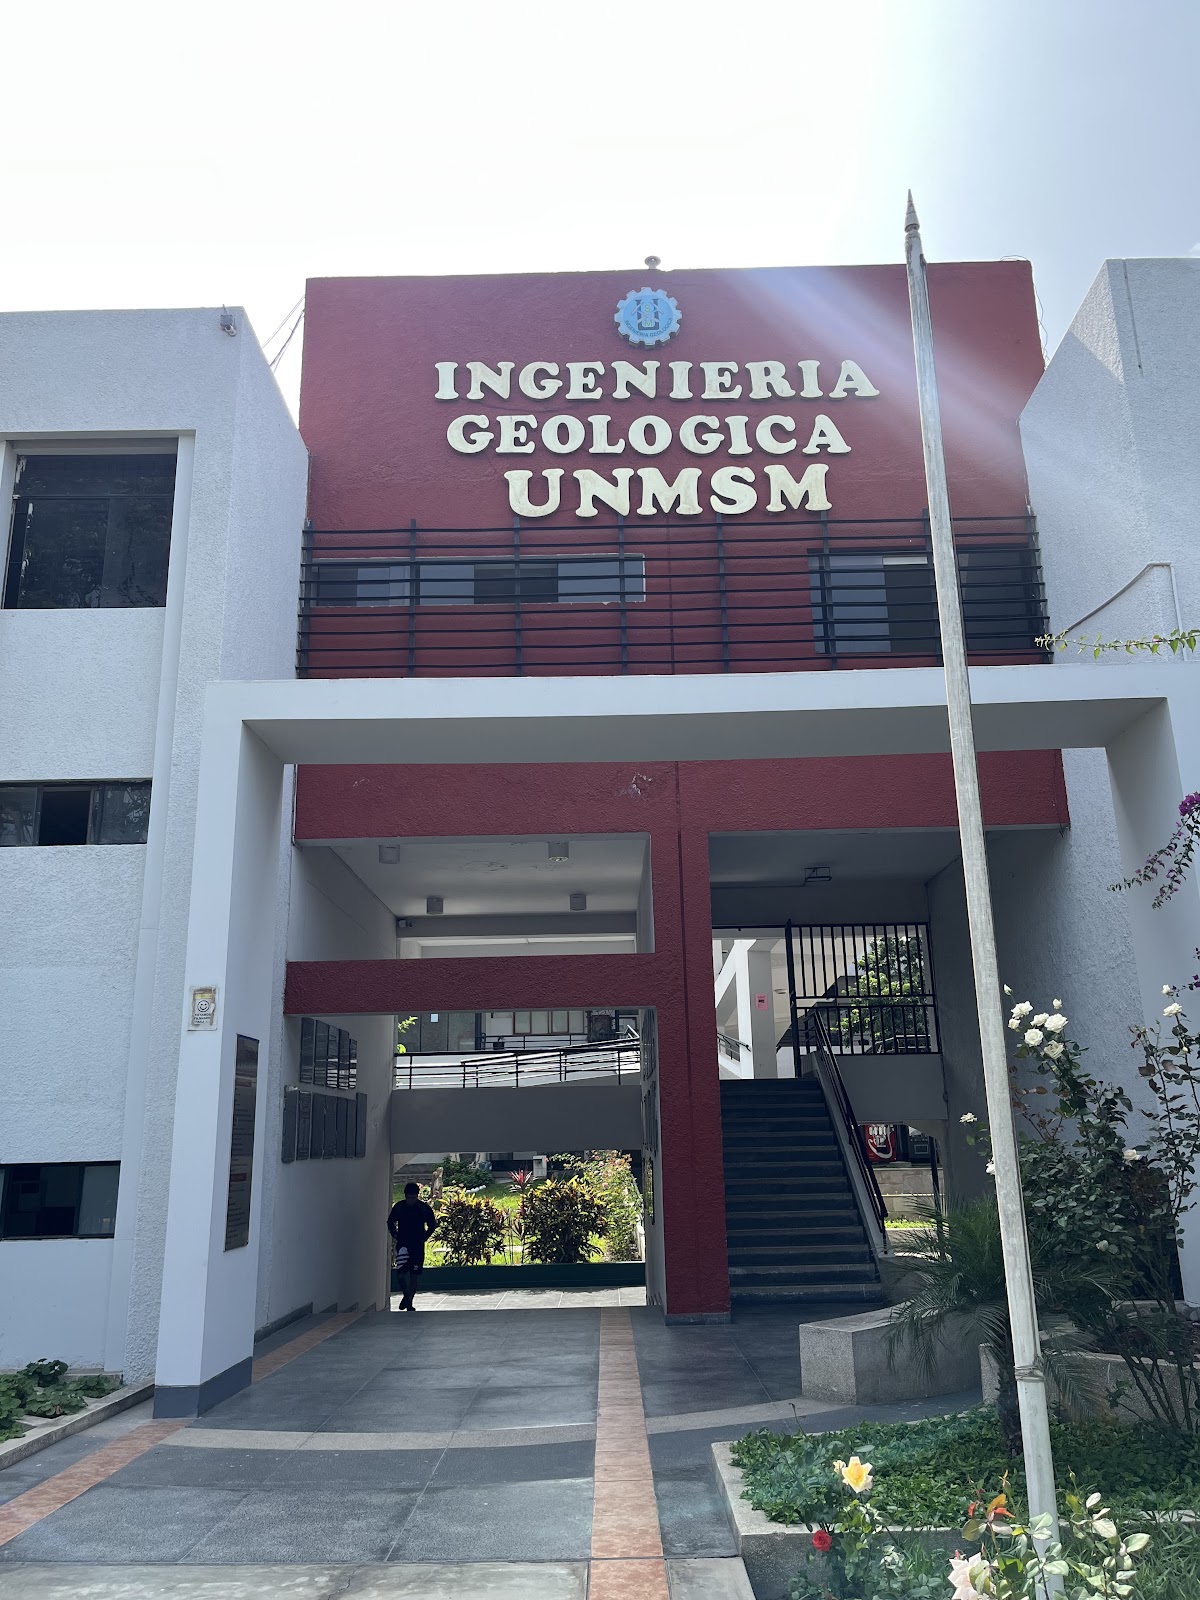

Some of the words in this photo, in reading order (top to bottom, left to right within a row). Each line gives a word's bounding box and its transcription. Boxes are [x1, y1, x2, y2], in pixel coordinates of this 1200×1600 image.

[434, 360, 881, 400] INGENIERIA
[446, 414, 852, 455] GEOLOGICA
[503, 463, 833, 518] UNMSM
